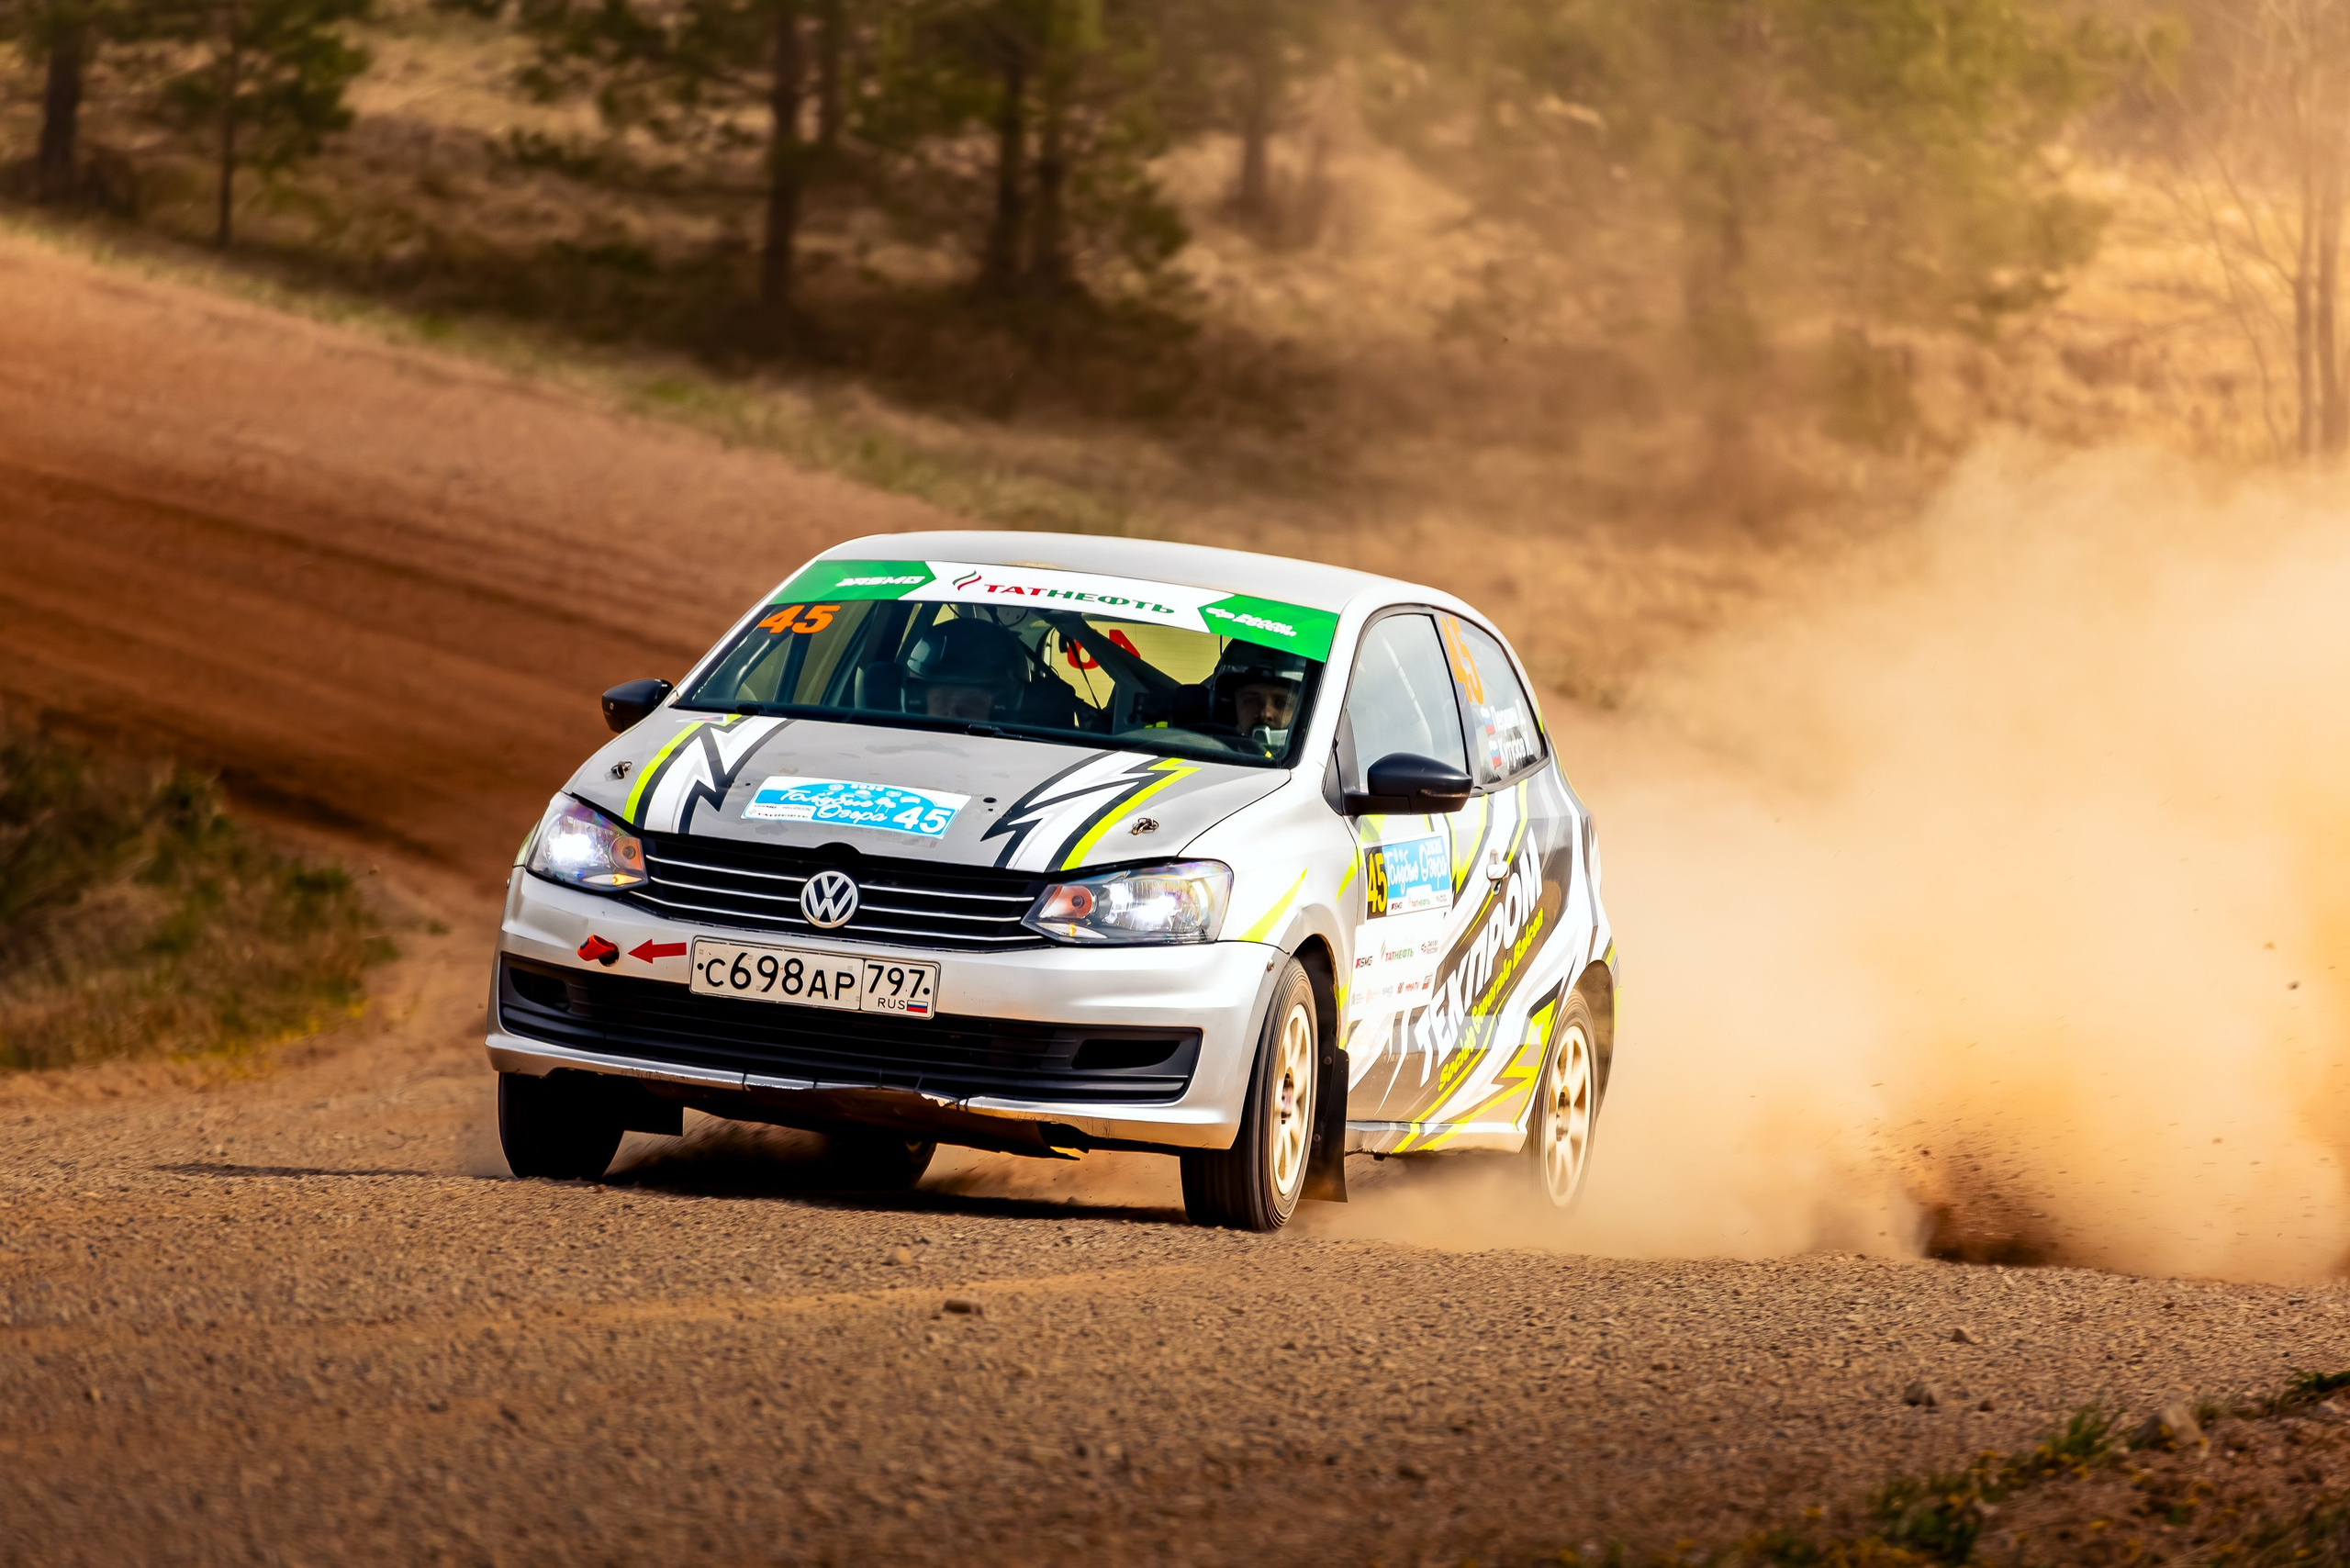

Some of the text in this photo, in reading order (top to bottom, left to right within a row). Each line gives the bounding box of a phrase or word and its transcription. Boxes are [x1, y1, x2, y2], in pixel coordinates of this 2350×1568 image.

[983, 583, 1175, 614] ТАТНЕФТЬ
[757, 604, 841, 634] 45
[1438, 615, 1484, 705] 45
[892, 806, 952, 834] 45
[1367, 852, 1388, 913] 45
[1385, 947, 1415, 962] ТАТНЕФТЬ
[1414, 826, 1543, 1088] ТЕХПРОМ
[867, 963, 926, 999] 797
[877, 997, 906, 1010] RUS
